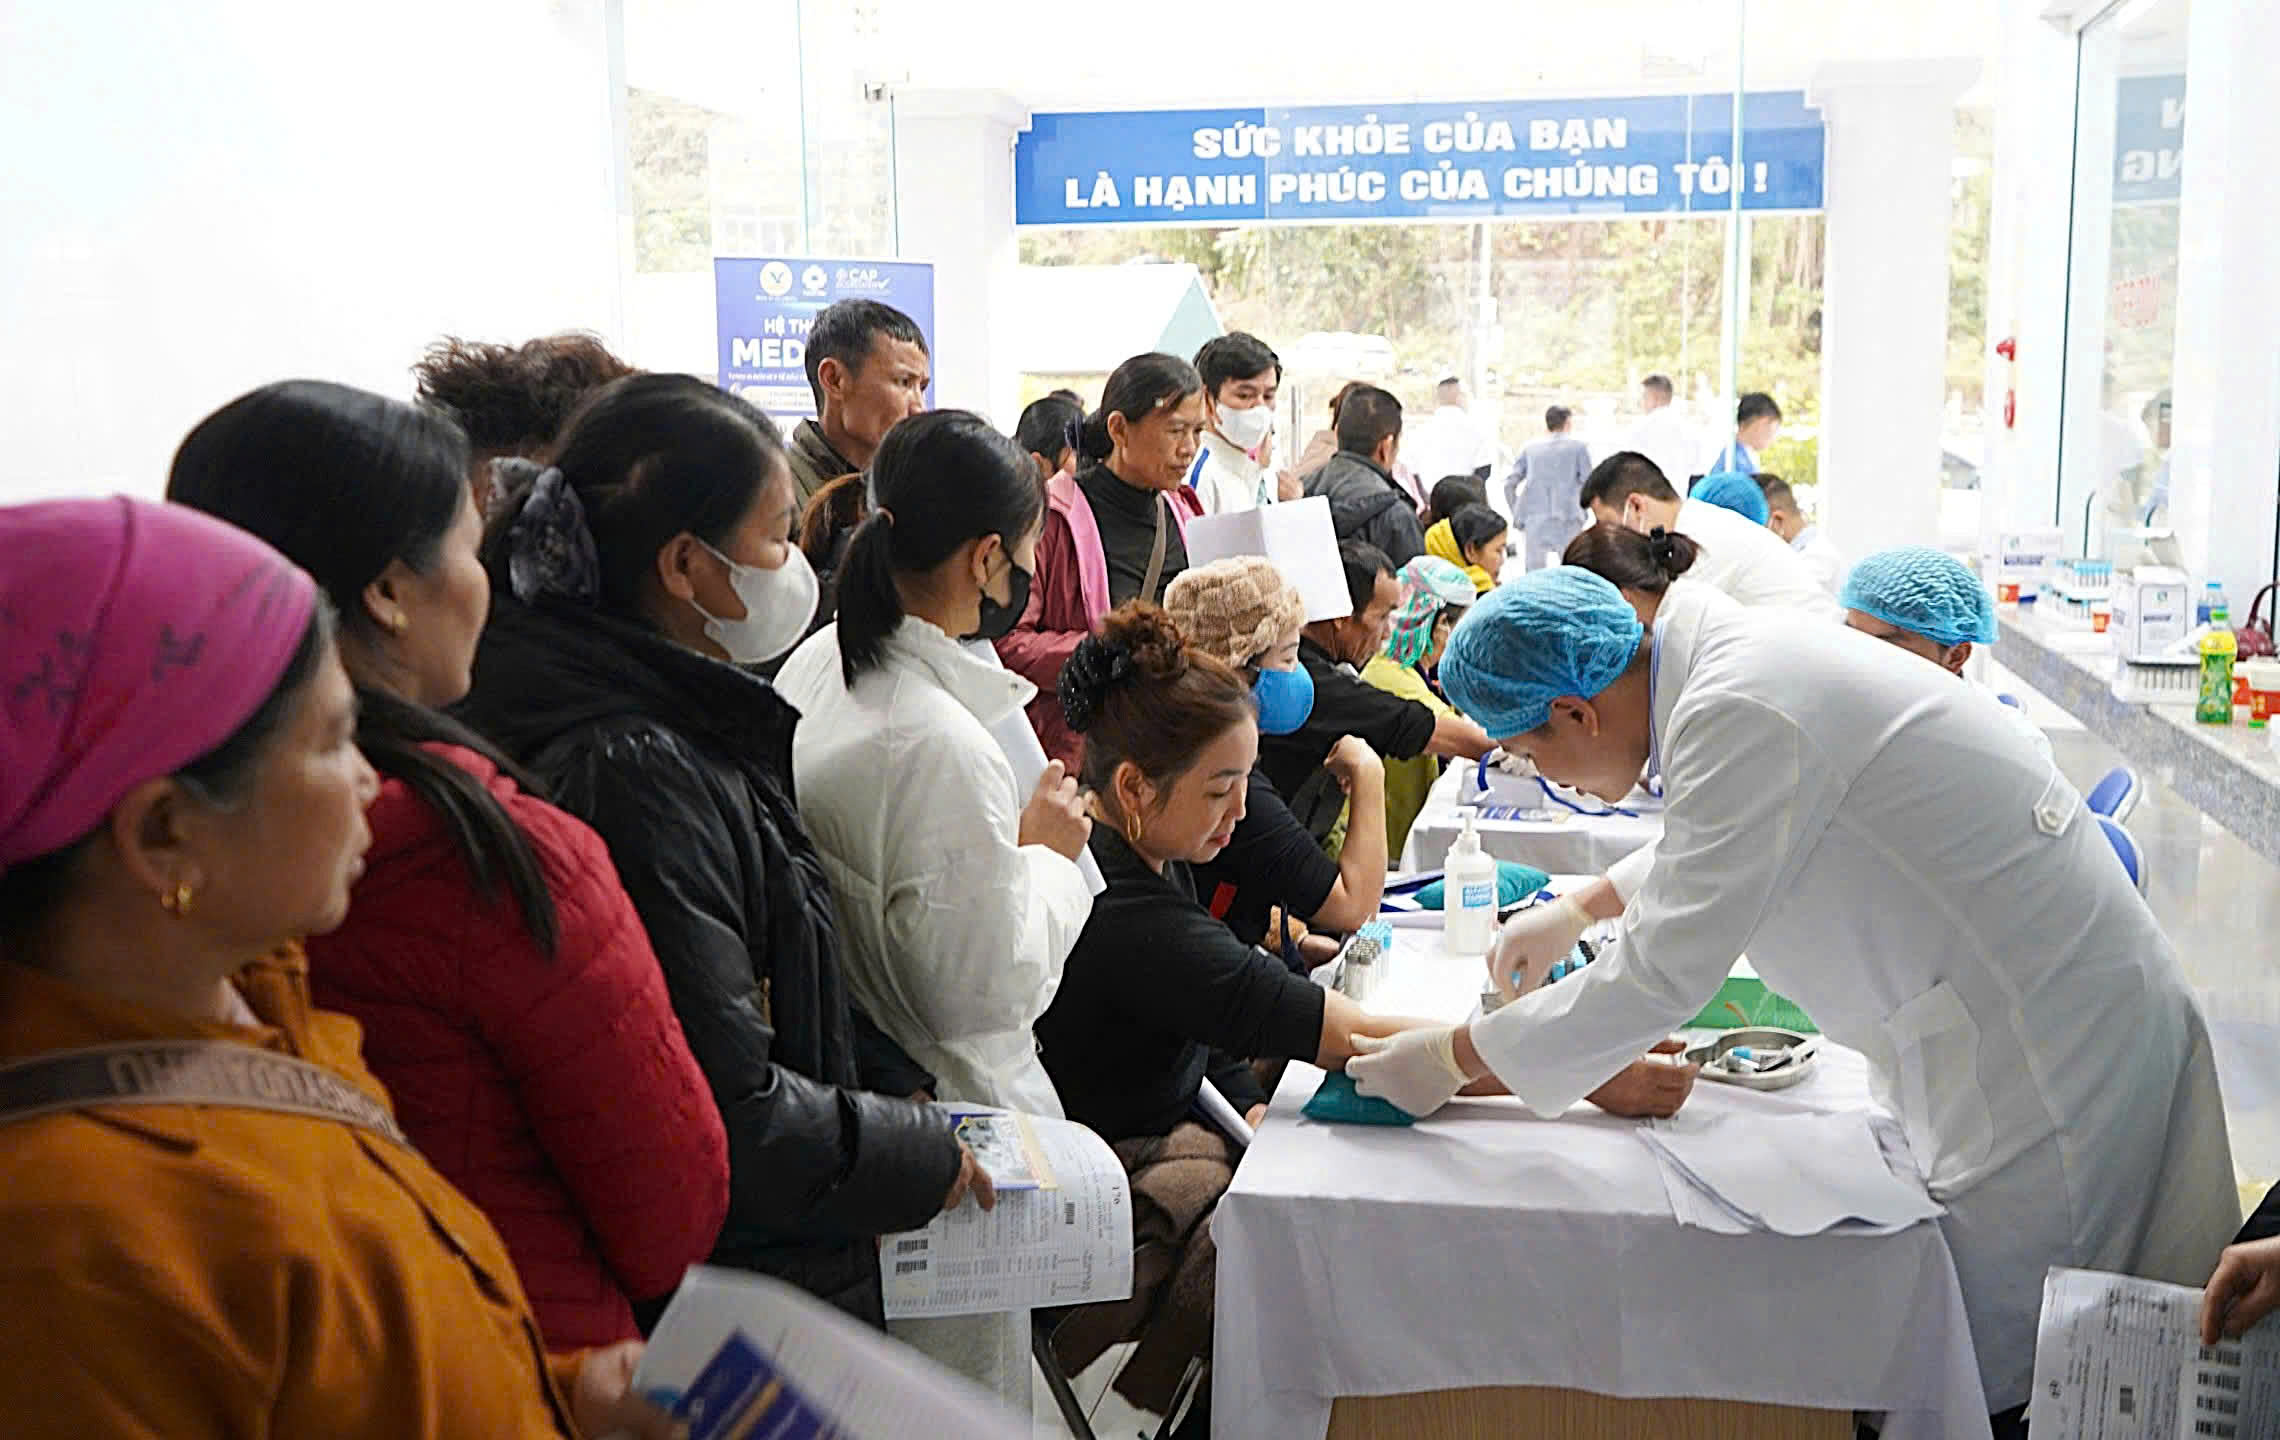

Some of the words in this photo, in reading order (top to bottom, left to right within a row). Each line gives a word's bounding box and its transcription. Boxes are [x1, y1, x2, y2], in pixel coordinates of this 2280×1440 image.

[1193, 120, 1281, 159] SỨC
[1294, 113, 1411, 156] KHỎE
[1423, 111, 1516, 153] CỦA
[1529, 118, 1628, 156] BẠN
[1065, 171, 1121, 208] LÀ
[1134, 175, 1256, 212] HẠNH
[1270, 166, 1386, 203] PHÚC
[1400, 160, 1489, 200] CỦA
[1503, 160, 1659, 199] CHÚNG
[789, 317, 816, 335] TH
